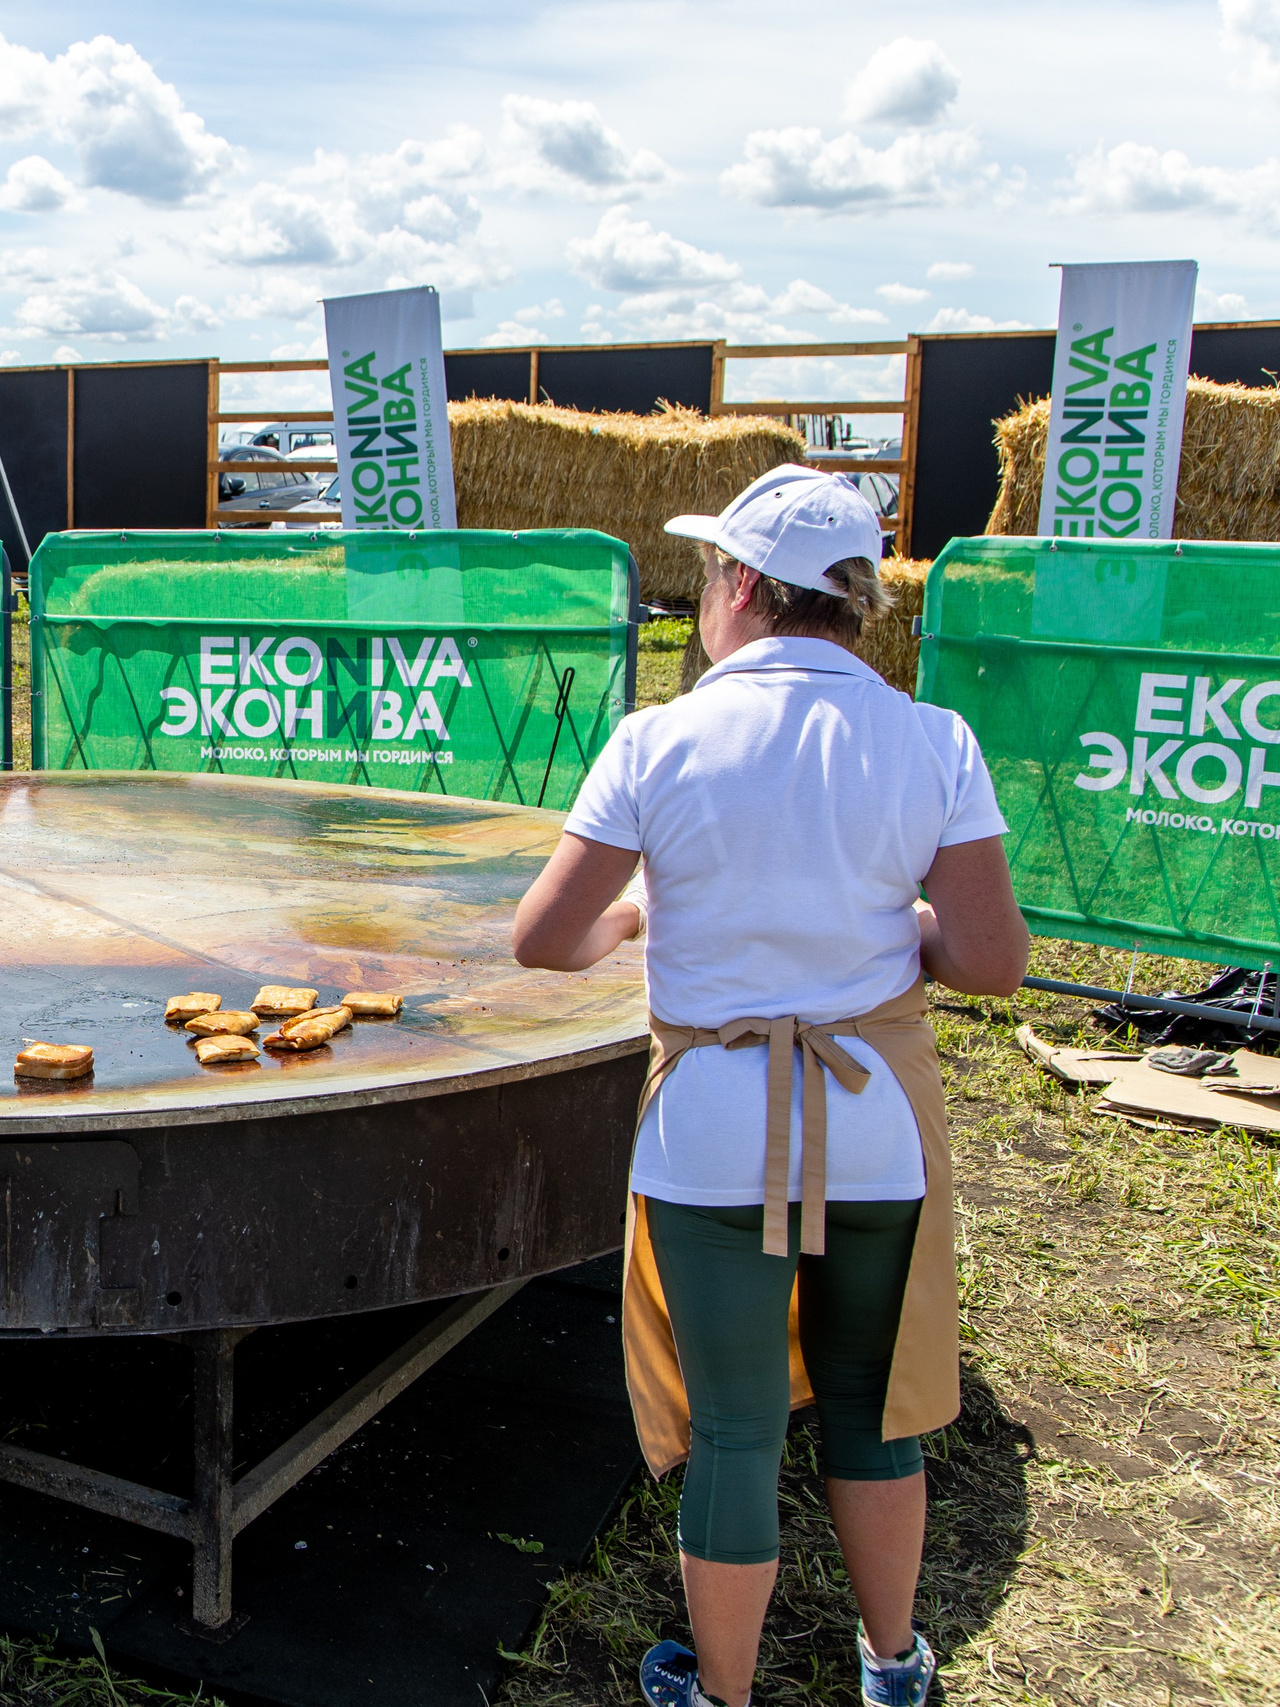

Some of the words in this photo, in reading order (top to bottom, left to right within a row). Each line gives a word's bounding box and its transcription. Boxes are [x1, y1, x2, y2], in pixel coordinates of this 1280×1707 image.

[420, 358, 431, 418] ГОРДИМСЯ
[1161, 339, 1177, 408] ГОРДИМСЯ
[423, 419, 432, 437] МЫ
[1158, 408, 1169, 428] МЫ
[425, 440, 437, 495] КОТОРЫМ
[1152, 430, 1166, 489] КОТОРЫМ
[429, 496, 441, 530] ЛОКО,
[1149, 489, 1162, 538] ОЛОКО,
[200, 636, 473, 687] EKONIVA
[159, 687, 450, 740] ЭКОНИВА
[201, 746, 268, 763] МОЛОКО,
[270, 747, 342, 763] КОТОРЫМ
[345, 749, 369, 762] МЫ
[373, 750, 453, 765] ГОРДИМСЯ
[1126, 807, 1217, 835] МОЛОКО,
